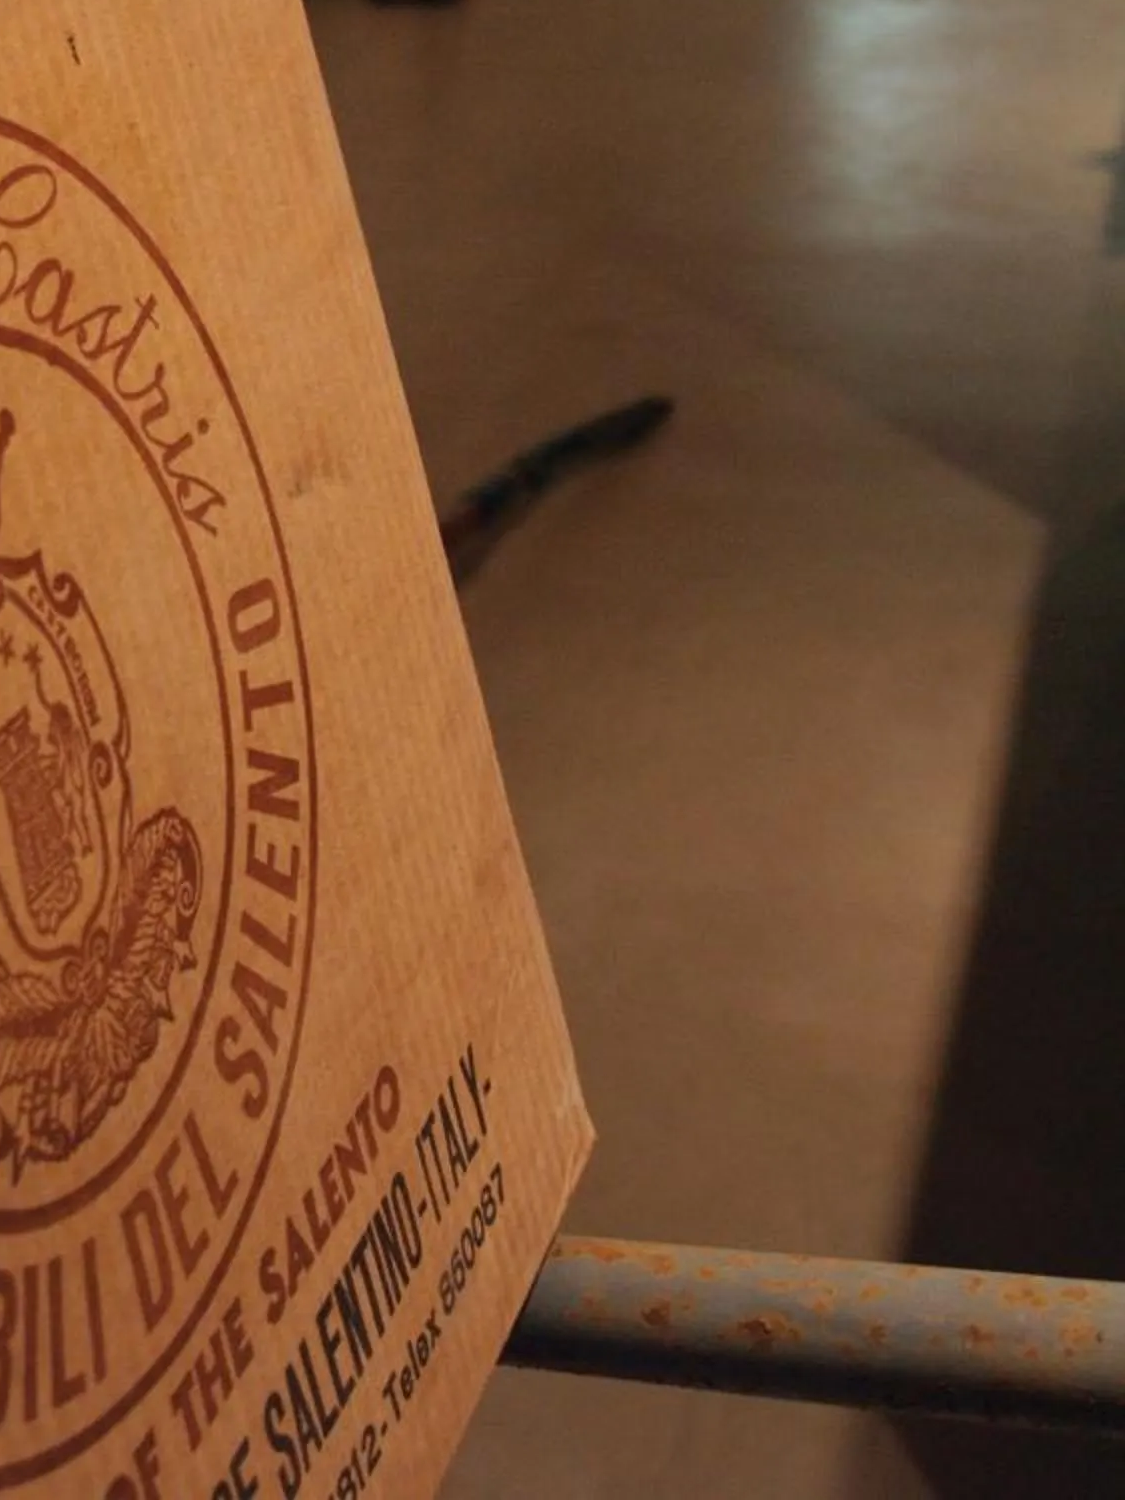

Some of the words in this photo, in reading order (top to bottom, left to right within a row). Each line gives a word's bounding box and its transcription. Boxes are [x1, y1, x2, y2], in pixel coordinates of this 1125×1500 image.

[119, 1110, 240, 1334] DEL
[213, 575, 301, 1121] SALENTO
[171, 1298, 255, 1452] THE
[258, 1064, 401, 1323] SALENTO
